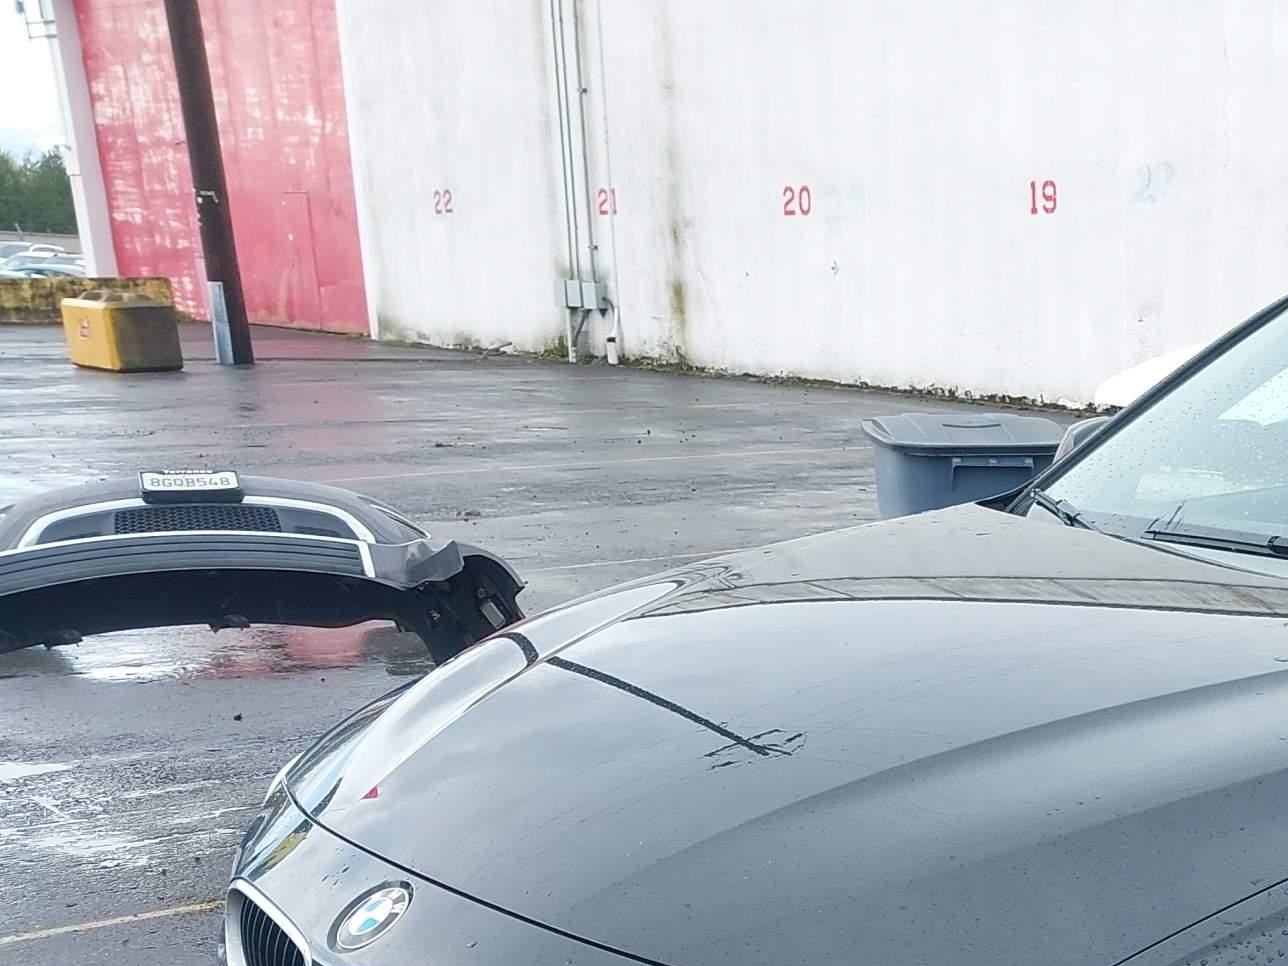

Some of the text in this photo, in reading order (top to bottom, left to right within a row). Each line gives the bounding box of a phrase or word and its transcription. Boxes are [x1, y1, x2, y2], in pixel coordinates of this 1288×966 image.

[434, 189, 454, 214] 22
[598, 188, 618, 216] 21
[783, 185, 812, 216] 20
[1029, 180, 1057, 215] 19
